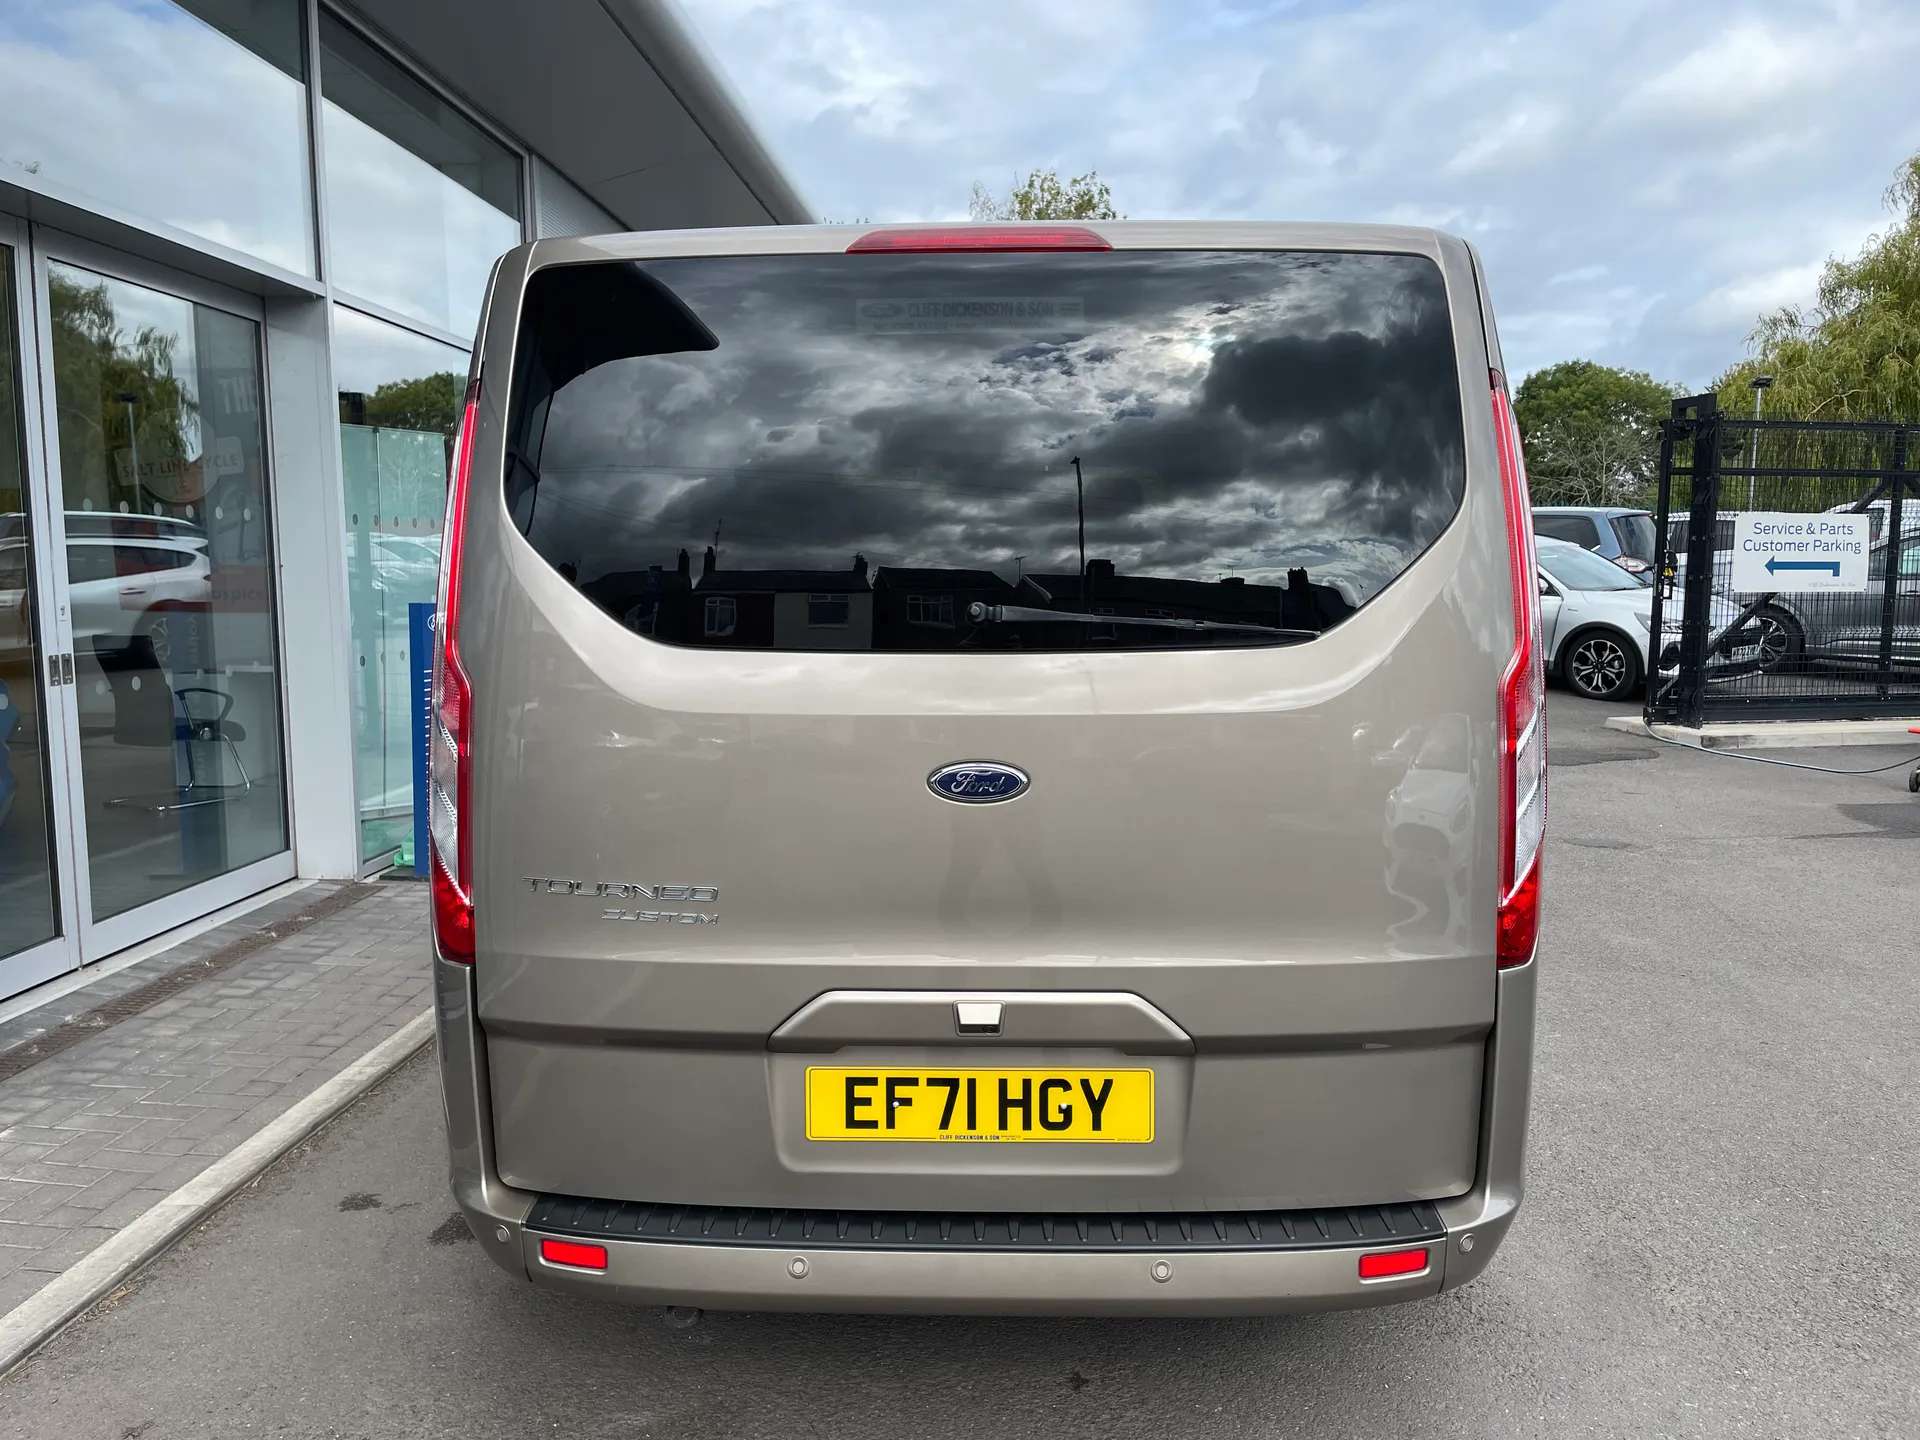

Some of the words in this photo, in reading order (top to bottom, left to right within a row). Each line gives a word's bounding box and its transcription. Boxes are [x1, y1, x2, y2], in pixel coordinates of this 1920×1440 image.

[1752, 522, 1801, 535] Service
[1806, 522, 1816, 535] &
[1819, 522, 1854, 535] Parts
[1743, 539, 1810, 552] Customer
[1813, 539, 1862, 555] Parking
[951, 770, 1005, 793] Ford
[521, 876, 719, 902] TOURNEO
[601, 908, 719, 925] CUSTOM
[844, 1076, 977, 1132] EF71
[997, 1077, 1114, 1132] HGY
